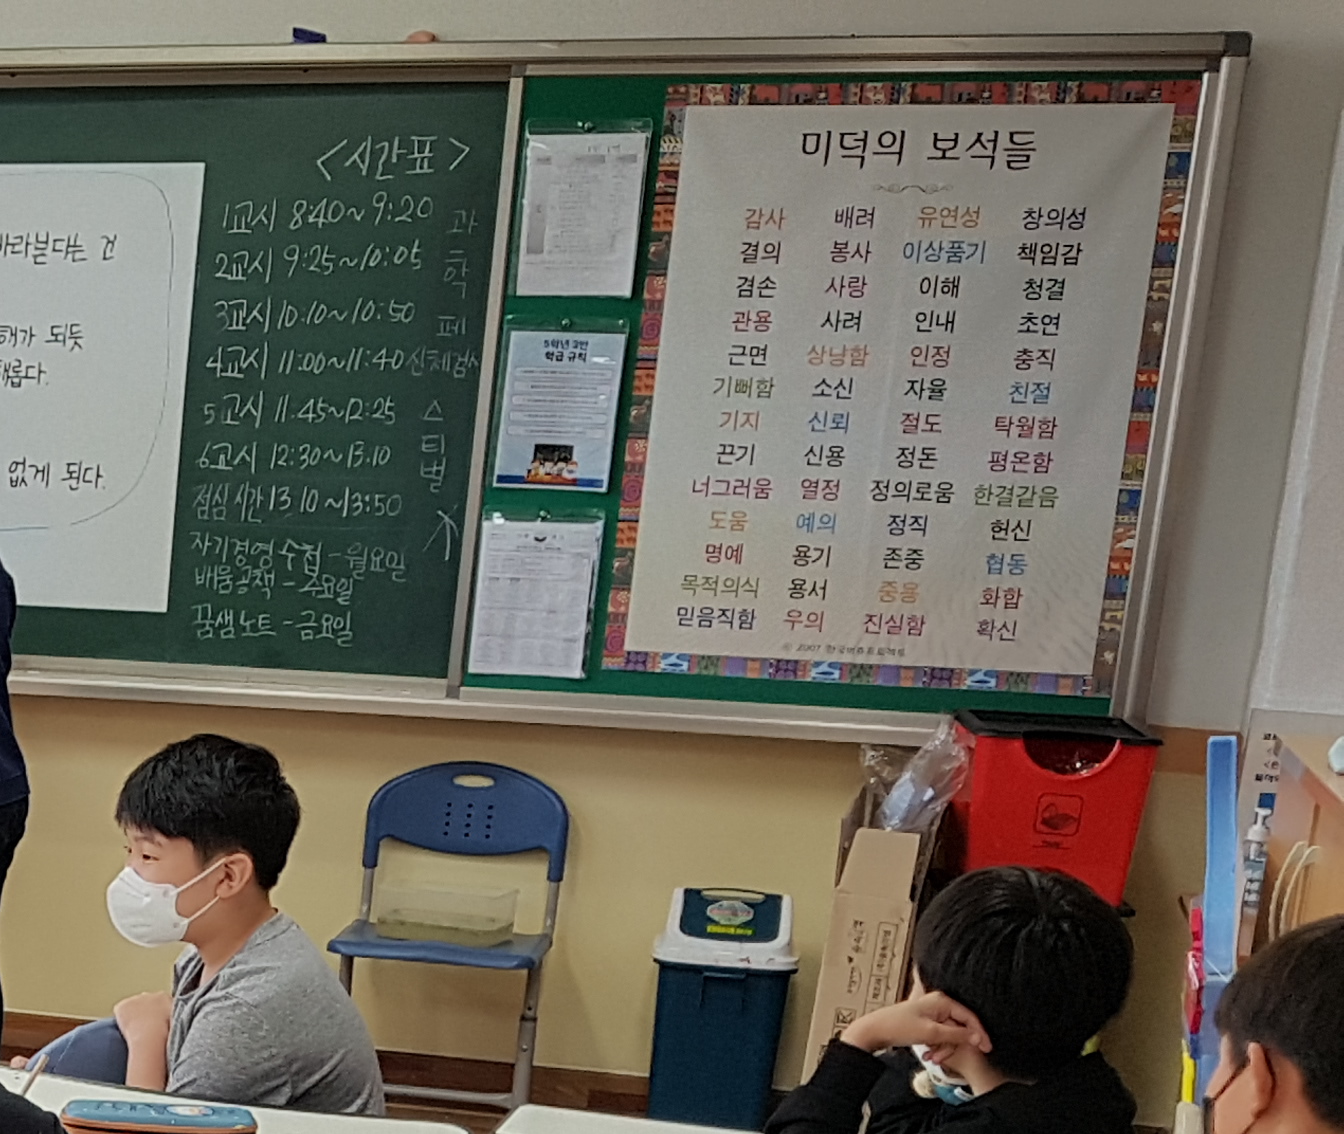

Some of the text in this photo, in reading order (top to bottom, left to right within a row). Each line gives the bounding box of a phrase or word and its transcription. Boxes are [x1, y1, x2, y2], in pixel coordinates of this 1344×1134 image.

[801, 128, 1037, 171] 미덕의 보석들
[222, 197, 276, 234] 1교시
[745, 206, 1087, 231] 감사 배려 유연성 창의성
[214, 247, 273, 284] 2교시
[739, 241, 1083, 266] 결의 봉사 이상품기 책임감
[736, 275, 1066, 301] 겸손 사랑 이해 청결
[214, 296, 272, 334] 3교시
[731, 310, 1061, 337] 관용 사려 인내 초연
[45, 322, 85, 352] 되듯
[206, 341, 268, 380] 4교시
[728, 343, 768, 367] 근면
[910, 345, 950, 369] 인정
[1012, 346, 1056, 371] 충직
[712, 376, 1051, 404] 기뻐함 소신 자율 친절
[204, 390, 263, 428] 5교시
[718, 410, 1058, 440] 기지 신뢰 절도 탁월함
[8, 455, 50, 489] 없게
[196, 440, 257, 474] 6교시
[716, 444, 1053, 473] 끈기 신용 정돈 평온함
[691, 476, 1059, 508] 너그러움 열정 정의로움 한결같음
[710, 510, 1032, 542] 도움 예의 정직 헌신
[704, 541, 1028, 576] 명예 용기 존중 협동
[679, 574, 760, 598] 목적의식
[787, 577, 828, 601] 용서
[979, 585, 1023, 610] 화합
[676, 607, 1017, 642] 믿음직함 우의 진실함 확신
